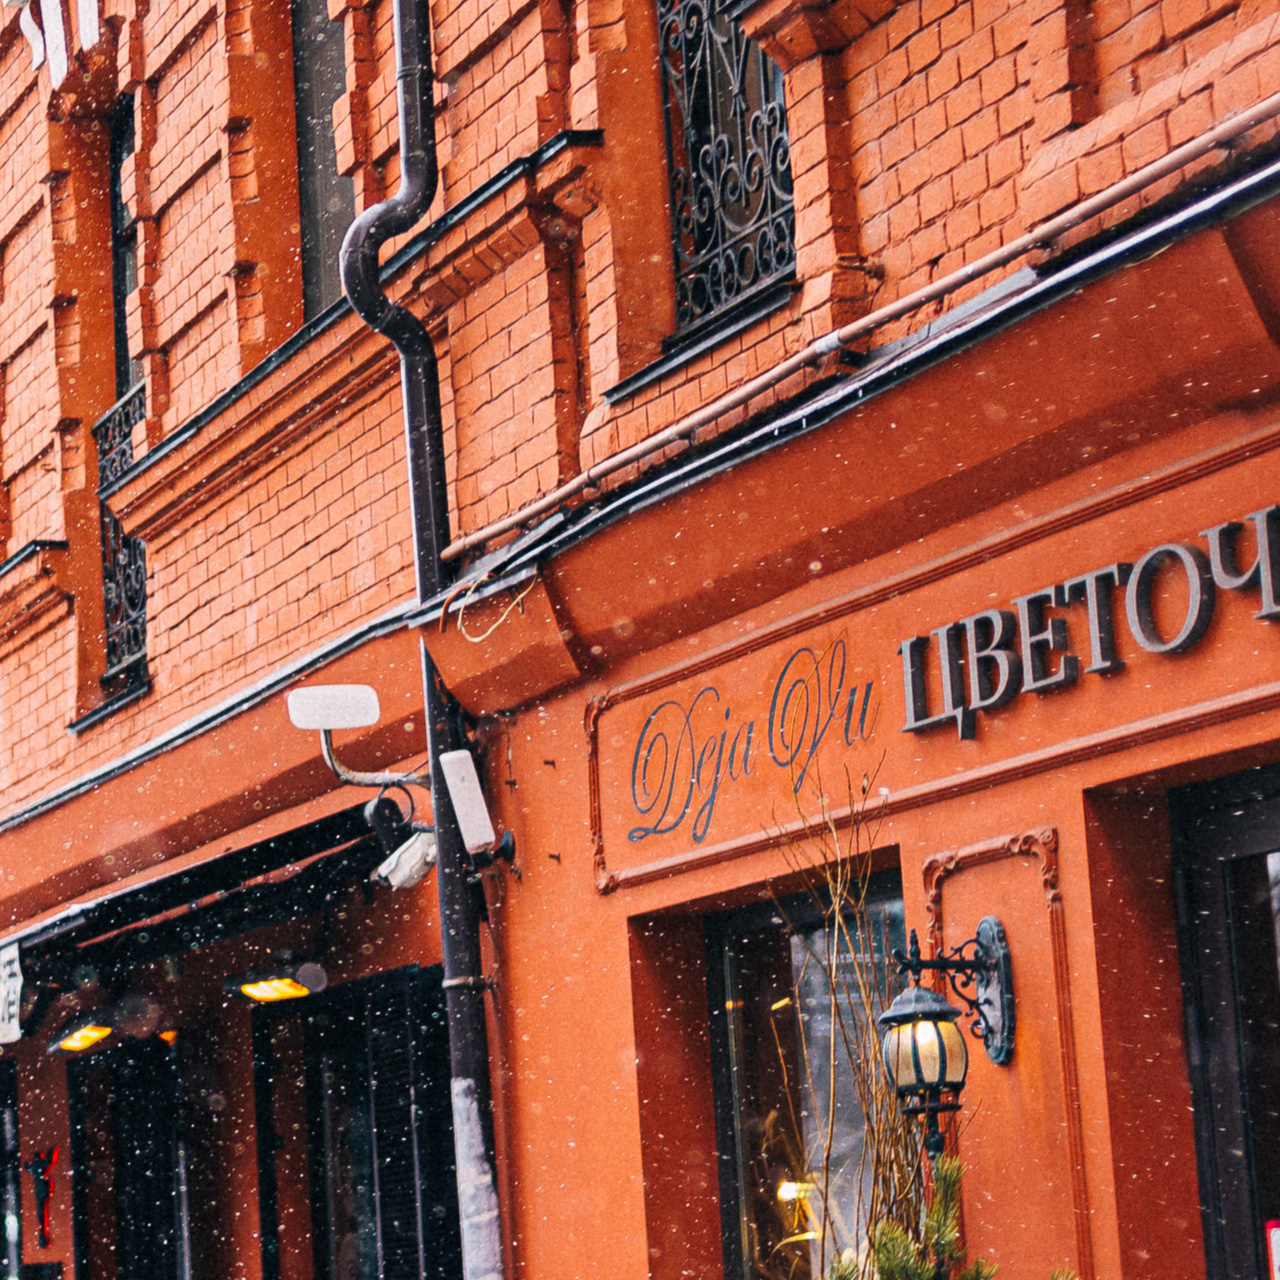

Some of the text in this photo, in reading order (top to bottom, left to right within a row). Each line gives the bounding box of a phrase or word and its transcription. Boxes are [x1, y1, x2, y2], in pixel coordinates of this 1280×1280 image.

[898, 504, 1280, 740] ЦВЕТОЧ
[628, 639, 880, 843] Deja Vu
